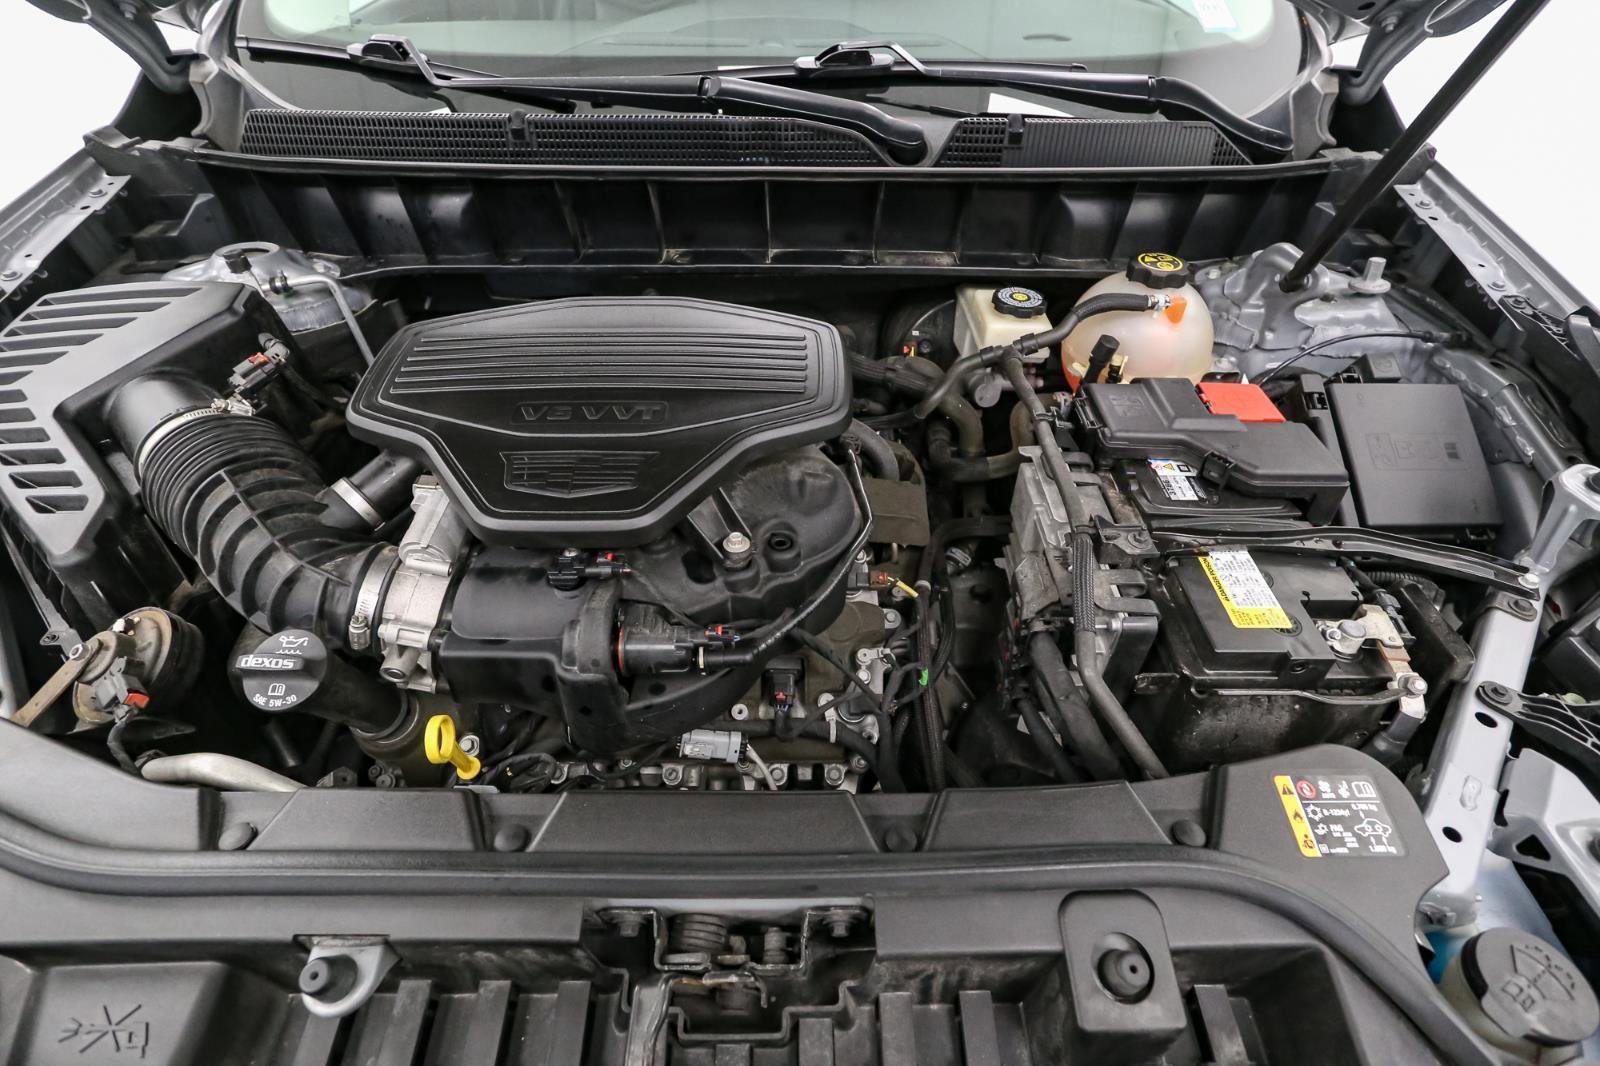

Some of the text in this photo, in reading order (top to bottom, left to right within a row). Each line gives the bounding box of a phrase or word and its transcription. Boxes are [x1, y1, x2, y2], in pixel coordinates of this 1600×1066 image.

[581, 404, 662, 421] VVT
[240, 654, 297, 669] dexos
[253, 693, 297, 707] SAE 5W-30
